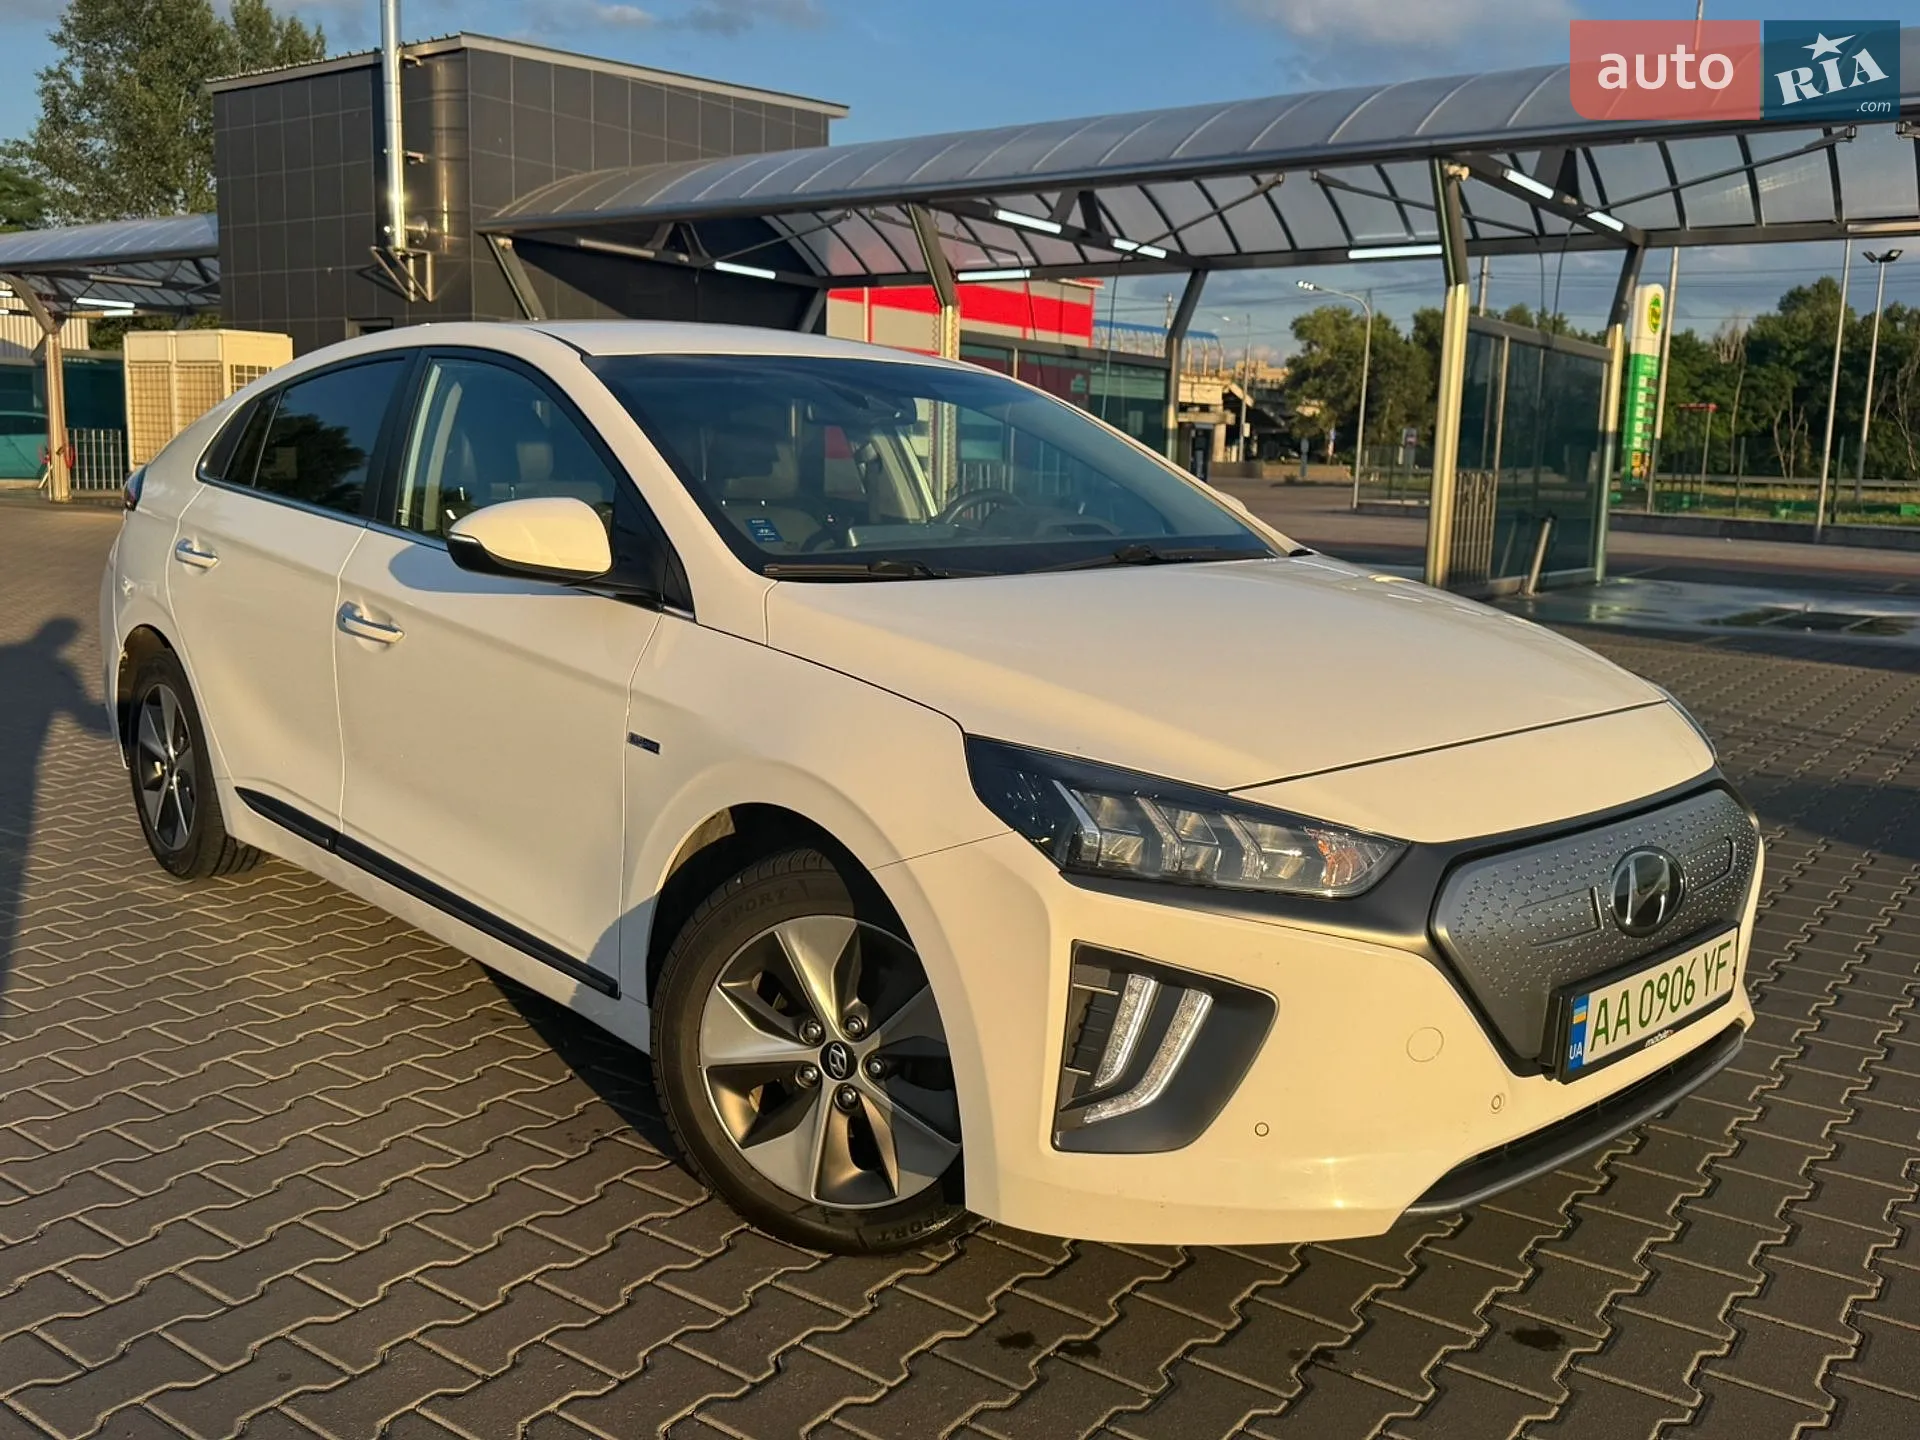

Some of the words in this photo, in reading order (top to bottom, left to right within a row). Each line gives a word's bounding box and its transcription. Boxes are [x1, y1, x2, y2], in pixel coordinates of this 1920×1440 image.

[720, 886, 789, 928] SPORT
[1590, 989, 1631, 1052] AA
[1639, 957, 1697, 1028] 0906
[1704, 940, 1731, 997] YF
[1569, 1041, 1583, 1060] UA
